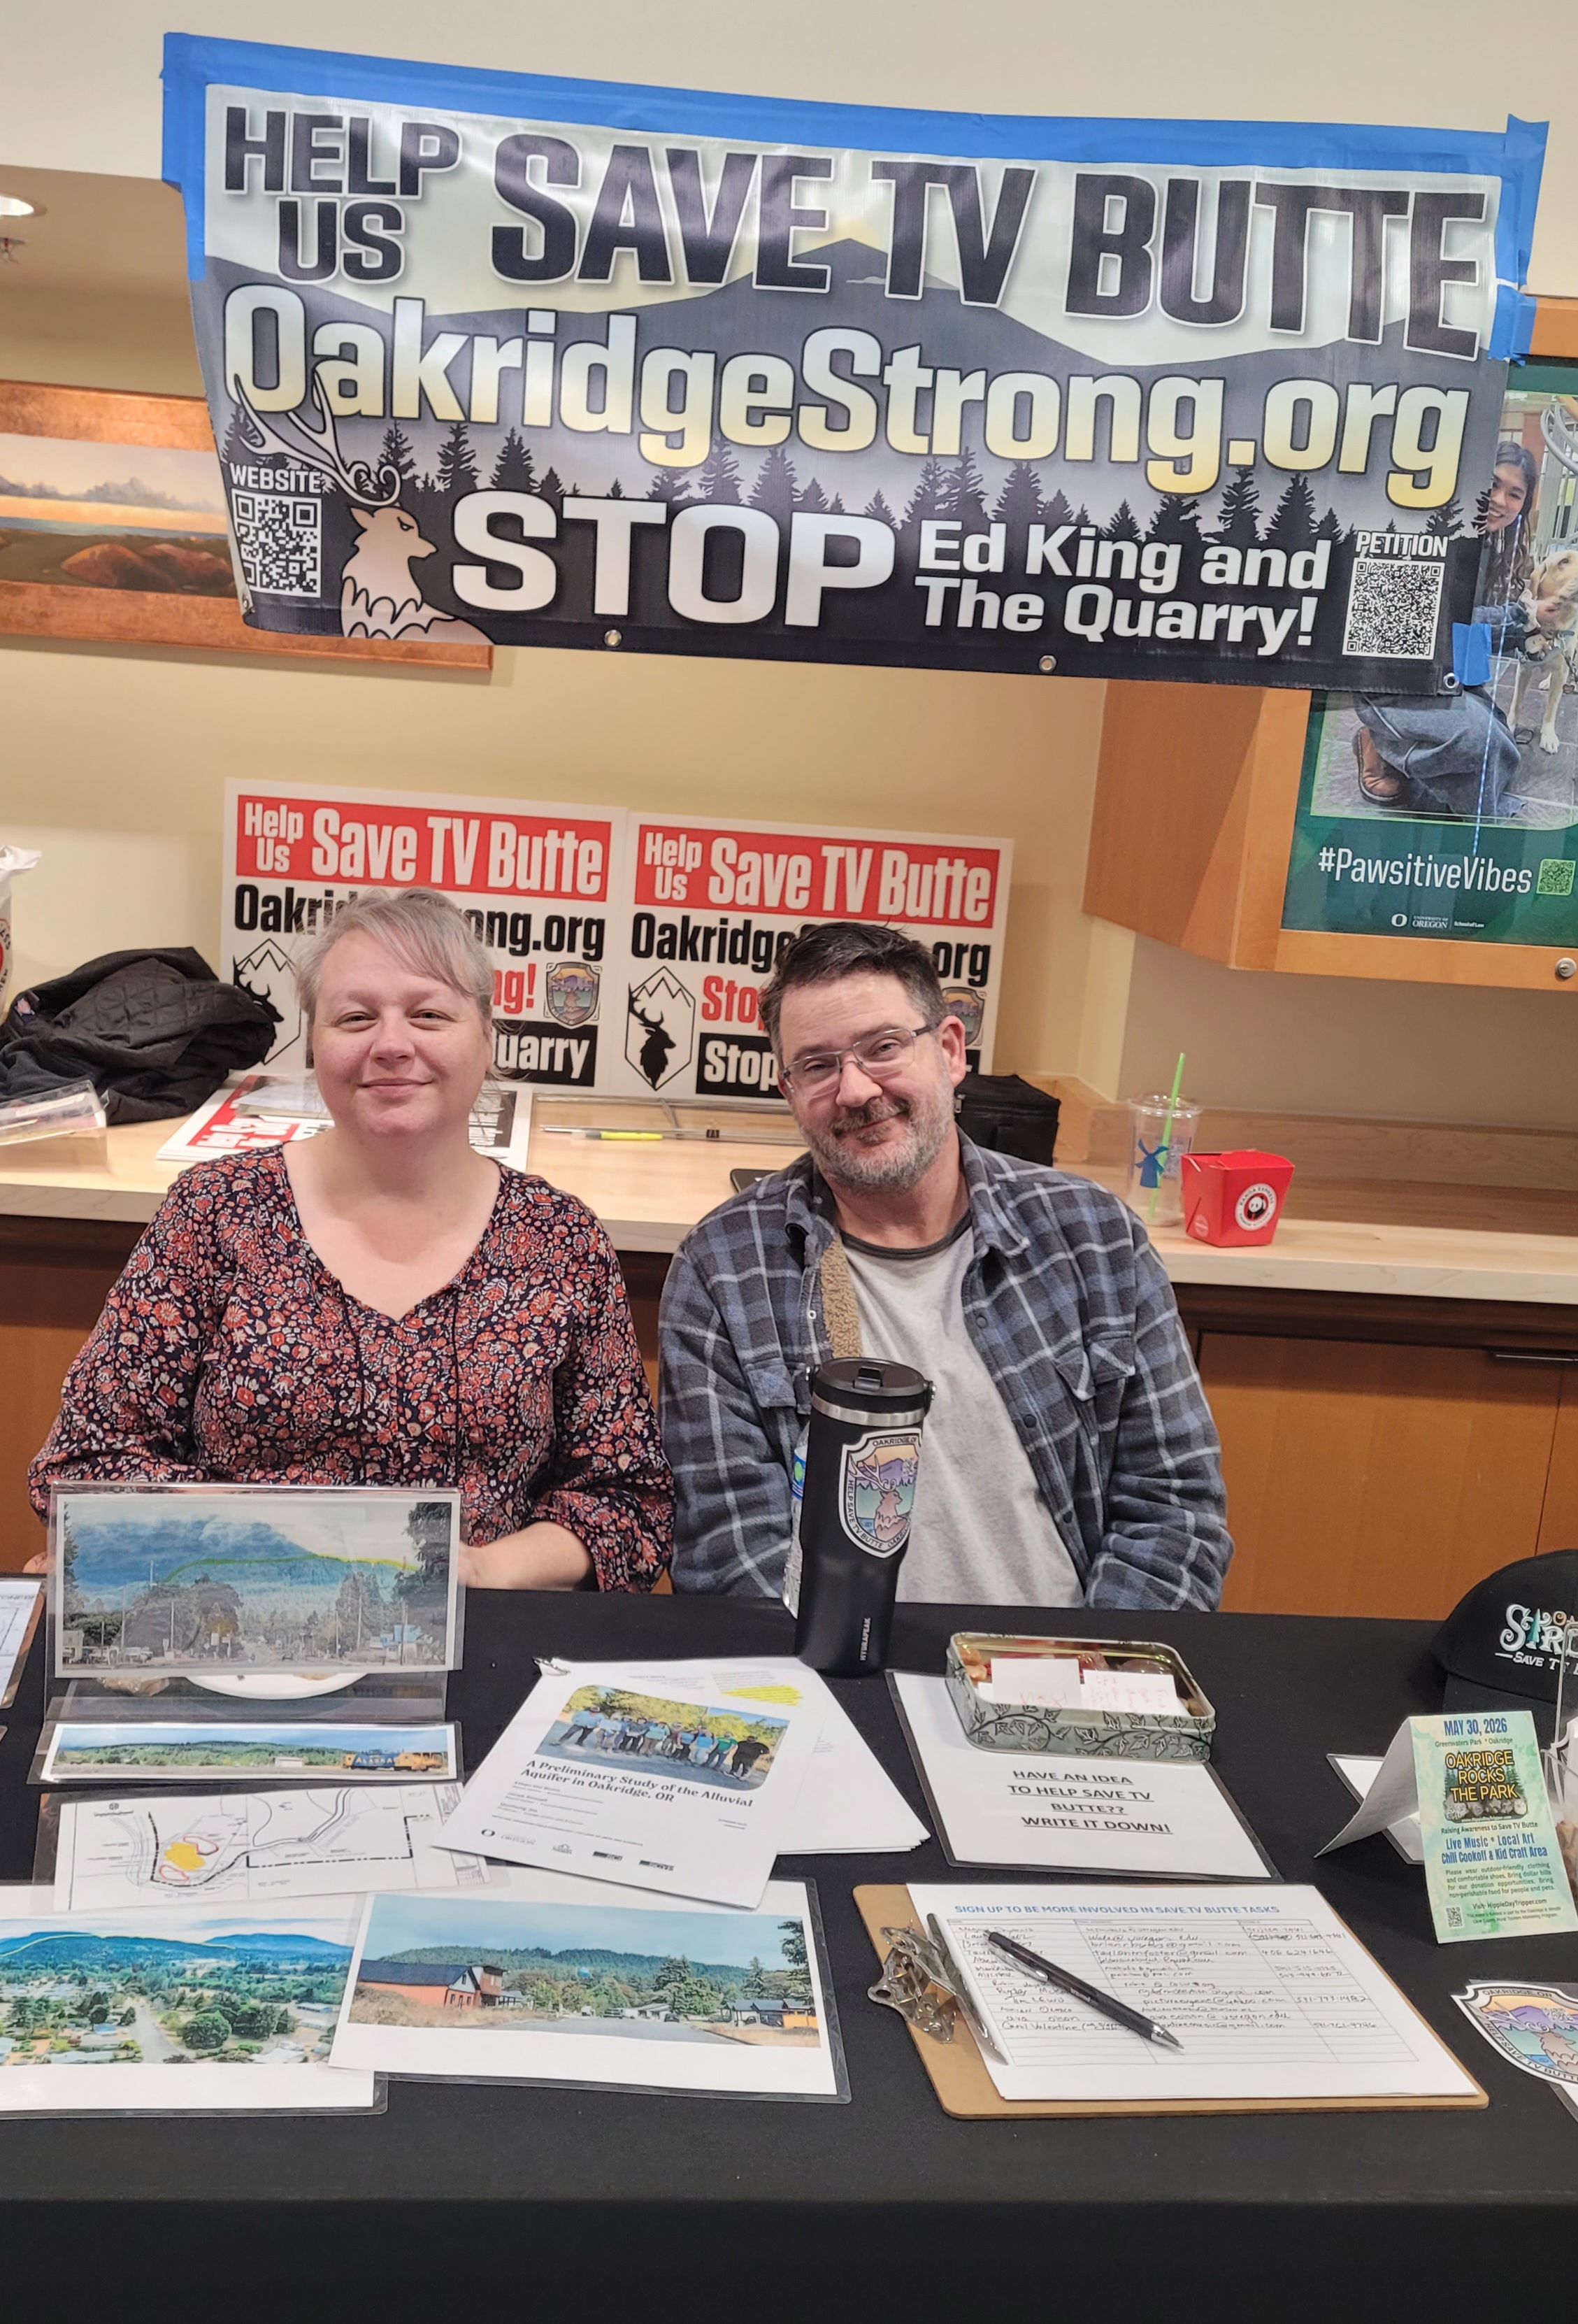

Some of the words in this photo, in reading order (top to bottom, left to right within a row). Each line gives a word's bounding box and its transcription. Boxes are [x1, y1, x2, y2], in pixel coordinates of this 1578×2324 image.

[224, 106, 462, 197] HELP
[490, 133, 835, 294] SAVE
[870, 159, 1037, 308] TV
[1064, 172, 1486, 362] BUTTE
[278, 199, 404, 283] US
[224, 285, 1470, 512] OakridgeStrong.org
[230, 462, 323, 494] WEBSITE
[452, 490, 895, 627] STOP
[919, 522, 1006, 573] Ed
[1025, 524, 1180, 594] King
[1199, 539, 1331, 591] and
[1356, 531, 1448, 559] PETITION
[915, 576, 1043, 632] The
[1063, 585, 1317, 656] Quarry!
[245, 802, 303, 843] Help
[255, 838, 289, 872] Us
[311, 808, 418, 881] Save
[427, 815, 481, 885] TV
[487, 820, 603, 895] Butte
[643, 832, 703, 873] Help
[654, 867, 688, 901] Us
[708, 837, 812, 910] Save
[822, 844, 873, 913] TV
[877, 849, 991, 922] Butte
[1318, 846, 1533, 894] #PawsitiveVibes
[1412, 920, 1448, 929] OREGON
[491, 1029, 590, 1079] uarry
[873, 1437, 910, 1446] OAKRIDGE
[847, 1502, 855, 1524] SAVE
[853, 1525, 861, 1534] TV
[861, 1532, 883, 1548] BUTTE
[1444, 1720, 1464, 1736] MAY
[1466, 1719, 1482, 1736] 30,
[1484, 1718, 1507, 1734] 2026
[1445, 1749, 1514, 1769] OAKRIDGE
[521, 1769, 571, 1783] Aquifer
[589, 1781, 651, 1799] Oakridge,
[655, 1792, 675, 1802] OR
[539, 1762, 617, 1783] Preliminary
[619, 1776, 659, 1790] Study
[677, 1787, 698, 1797] the
[701, 1791, 754, 1807] Alluvial
[1007, 1785, 1031, 1794] TO
[1036, 1787, 1077, 1797] HELP
[1083, 1789, 1126, 1799] SAVE
[1128, 1791, 1151, 1800] TV
[1013, 1771, 1059, 1780] HAVE
[1092, 1775, 1133, 1784] IDEA
[1458, 1768, 1505, 1784] ROCKS
[1051, 1803, 1125, 1813] BUTTE??
[1451, 1786, 1478, 1802] THE
[1480, 1784, 1520, 1801] PARK
[1021, 1817, 1080, 1827] WRITE
[1083, 1820, 1098, 1828] IT
[1104, 1820, 1172, 1832] DOWN!
[1446, 1838, 1462, 1850] Live
[1464, 1836, 1489, 1848] Music
[1498, 1834, 1520, 1846] Local
[1522, 1832, 1535, 1844] Art
[1442, 1852, 1458, 1865] Chili
[1458, 1851, 1487, 1862] Cookoff
[1489, 1851, 1493, 1860] &
[1495, 1848, 1508, 1860] Kid
[1509, 1847, 1528, 1858] Craft
[1530, 1846, 1548, 1858] Area
[1079, 1906, 1139, 1914] INVOLVED
[1487, 1899, 1547, 1909] HippieDayTripper.com
[1484, 2023, 1504, 2043] HELP
[1502, 2041, 1525, 2061] SAVE
[1526, 2060, 1542, 2069] TV
